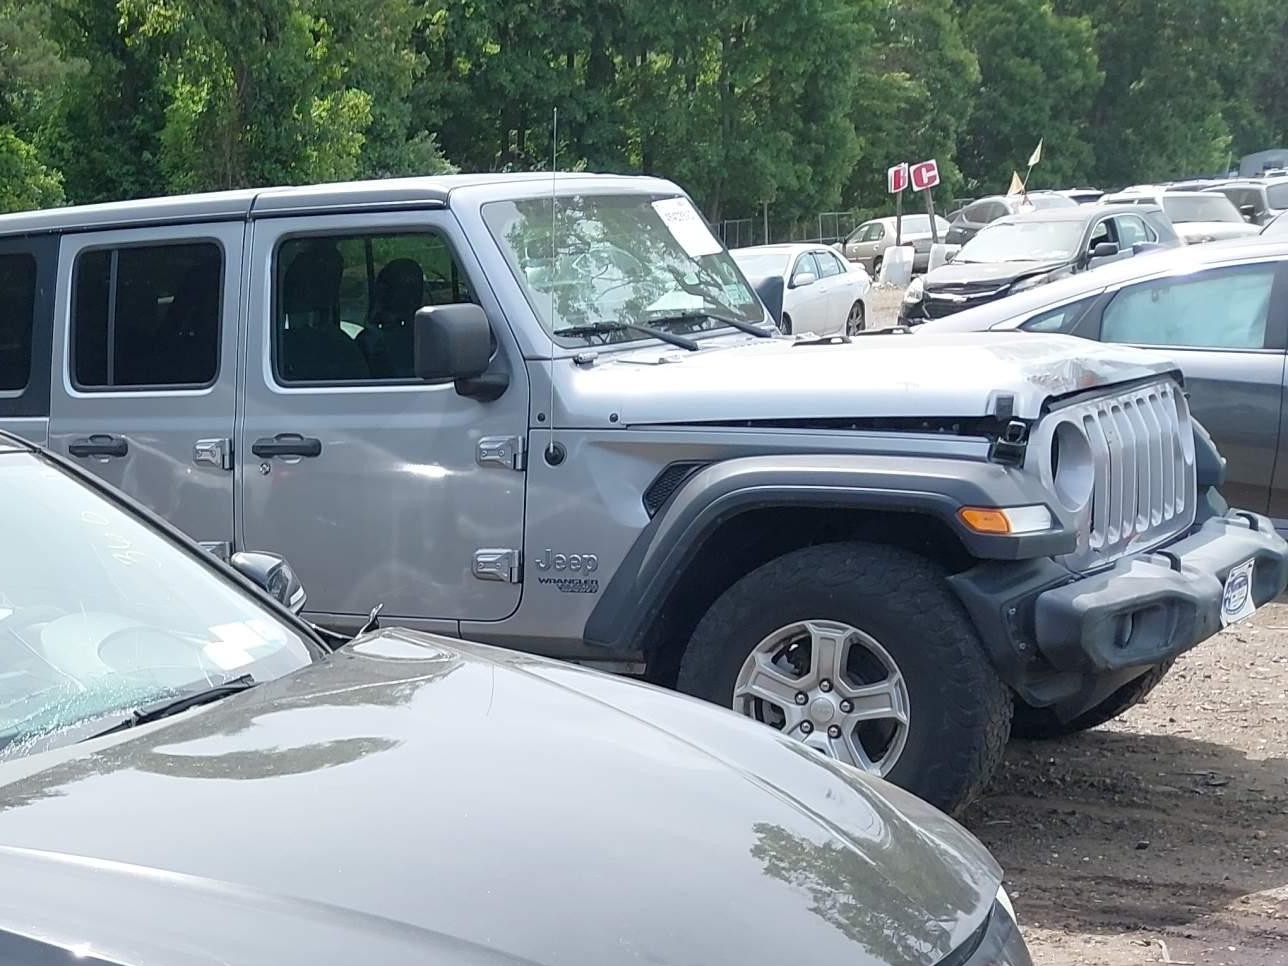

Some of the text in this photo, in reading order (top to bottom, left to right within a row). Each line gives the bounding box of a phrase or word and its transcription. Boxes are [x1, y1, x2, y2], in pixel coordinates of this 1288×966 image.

[912, 162, 938, 188] C
[535, 548, 598, 577] Jeep
[537, 577, 599, 585] WRANGLER
